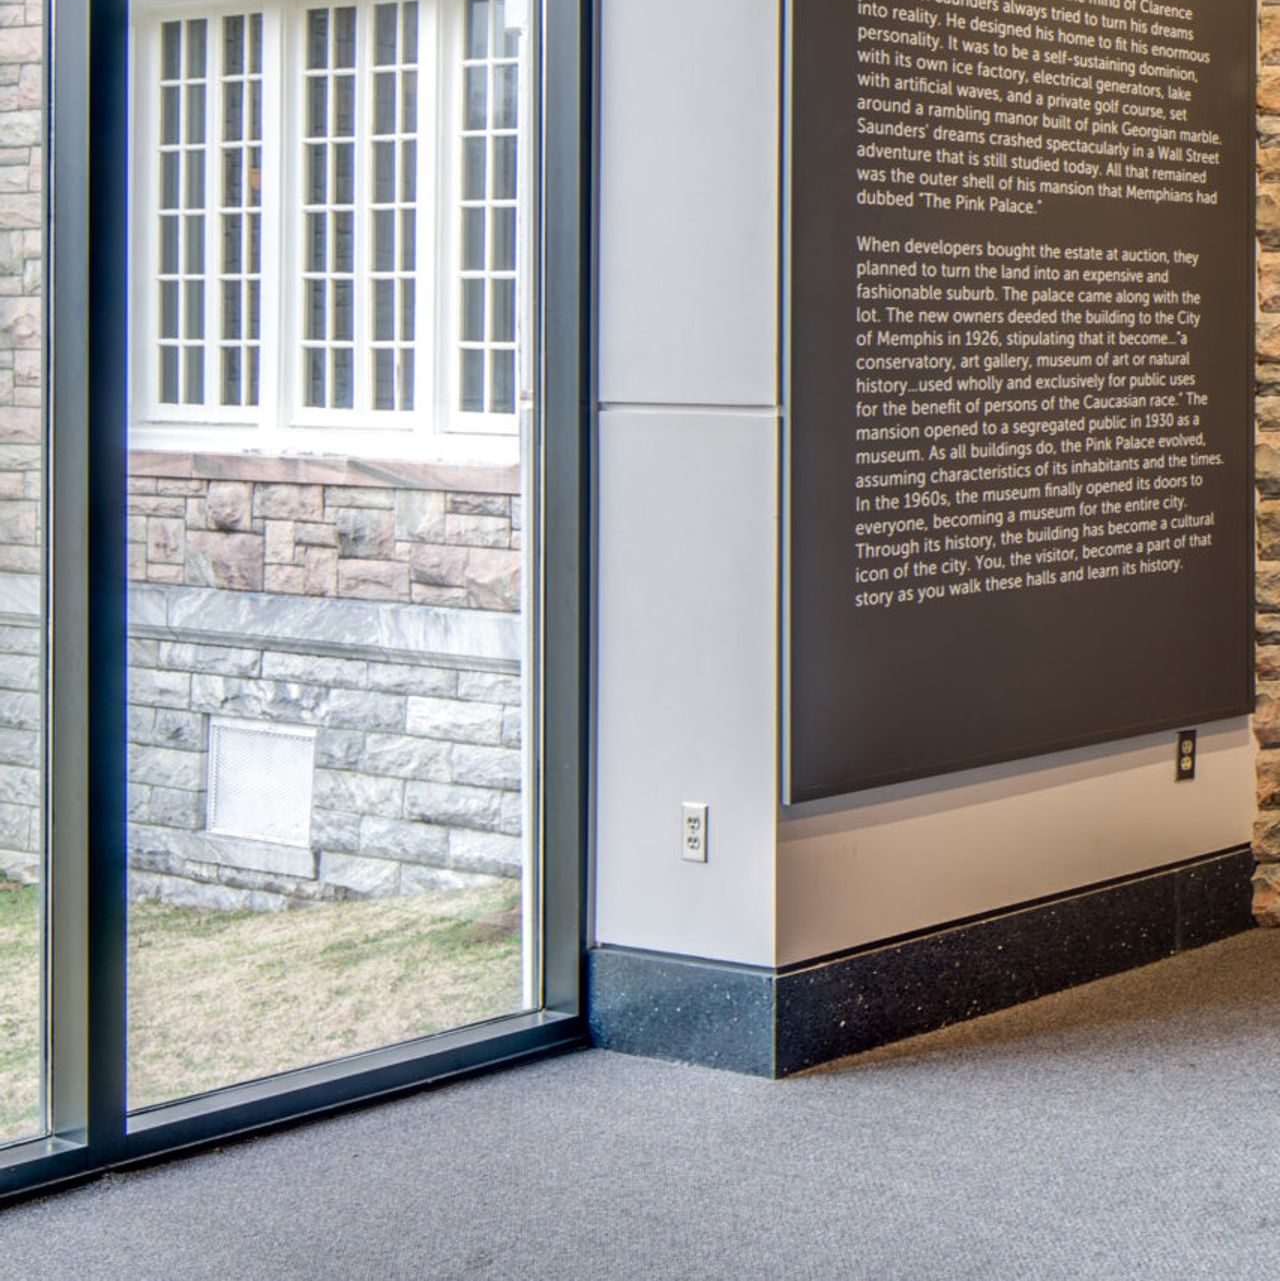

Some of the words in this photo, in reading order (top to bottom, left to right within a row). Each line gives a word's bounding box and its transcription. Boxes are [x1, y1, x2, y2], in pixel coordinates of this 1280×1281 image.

[892, 7, 941, 29] reality.
[946, 11, 966, 29] He
[969, 15, 1031, 38] designed
[1035, 24, 1054, 41] his
[1057, 28, 1095, 47] home
[1098, 35, 1112, 50] to
[1115, 36, 1127, 52] fit
[1130, 38, 1148, 55] his
[1151, 44, 1210, 63] enormous
[1002, 0, 1047, 21] always
[1051, 6, 1080, 24] tried
[1084, 11, 1098, 26] to
[1101, 14, 1127, 30] turn
[1130, 17, 1147, 34] his
[1150, 21, 1194, 41] dreams
[857, 26, 942, 52] personality.
[948, 34, 958, 51] It
[962, 40, 989, 55] was
[993, 41, 1008, 57] to
[1011, 43, 1028, 60] be
[1032, 49, 1040, 61] a
[1043, 49, 1135, 77] self-sustaining
[1138, 60, 1198, 83] dominion,
[857, 47, 890, 65] with
[895, 50, 912, 68] its
[916, 57, 947, 72] own
[952, 58, 973, 75] ice
[977, 61, 1028, 85] factory,
[1032, 69, 1092, 89] electrical
[1095, 79, 1164, 99] generators,
[1167, 84, 1191, 101] lake
[857, 71, 890, 88] with
[894, 76, 952, 96] artificial
[956, 84, 1002, 102] waves,
[1006, 89, 1032, 104] and
[1035, 93, 1043, 105] a
[1047, 93, 1091, 111] private
[1094, 98, 1119, 115] golf
[1121, 103, 1166, 120] course,
[1169, 108, 1187, 121] set
[856, 97, 910, 114] around
[915, 103, 923, 115] a
[928, 103, 990, 125] rambling
[994, 111, 1038, 127] manor
[1042, 112, 1071, 130] built
[1074, 116, 1089, 131] of
[1091, 118, 1118, 136] pink
[1121, 120, 1176, 142] Georgian
[1179, 129, 1221, 145] marble.
[856, 142, 932, 162] adventure
[935, 147, 964, 164] that
[968, 150, 979, 166] is
[983, 152, 1007, 168] still
[1010, 155, 1059, 172] studied
[1063, 159, 1102, 179] today.
[1105, 161, 1121, 177] All
[1124, 163, 1149, 179] that
[1152, 168, 1207, 184] remained
[932, 125, 985, 144] dreams
[989, 132, 1042, 149] crashed
[1046, 138, 1129, 160] spectacularly
[1132, 143, 1144, 158] in
[1146, 147, 1154, 159] a
[1157, 145, 1183, 161] Wall
[1185, 147, 1219, 164] Street
[856, 168, 886, 182] was
[890, 167, 915, 184] the
[919, 171, 958, 187] outer
[962, 172, 994, 189] shell
[998, 175, 1013, 190] of
[1016, 176, 1036, 192] his
[1039, 180, 1094, 196] mansion
[1097, 182, 1122, 198] that
[1126, 184, 1193, 203] Memphians
[1196, 189, 1217, 204] had
[856, 188, 913, 207] dubbed
[955, 194, 985, 211] Pink
[856, 235, 900, 252] When
[904, 237, 983, 258] developers
[986, 241, 1036, 261] bought
[1039, 244, 1061, 259] the
[1064, 246, 1102, 260] estate
[1106, 247, 1118, 261] at
[1121, 248, 1169, 264] auction,
[1173, 249, 1198, 267] they
[856, 259, 916, 278] planned
[921, 263, 937, 277] to
[941, 263, 970, 278] turn
[974, 263, 997, 279] the
[1001, 263, 1030, 280] land
[1034, 265, 1060, 280] into
[1063, 269, 1079, 281] an
[1082, 268, 1143, 285] expensive
[1146, 269, 1168, 283] and
[856, 282, 942, 300] fashionable
[946, 285, 997, 301] suburb.
[1002, 285, 1028, 302] The
[1031, 287, 1074, 305] palace
[1077, 290, 1112, 303] came
[1115, 288, 1150, 307] along
[1152, 289, 1178, 304] with
[1181, 290, 1200, 304] the
